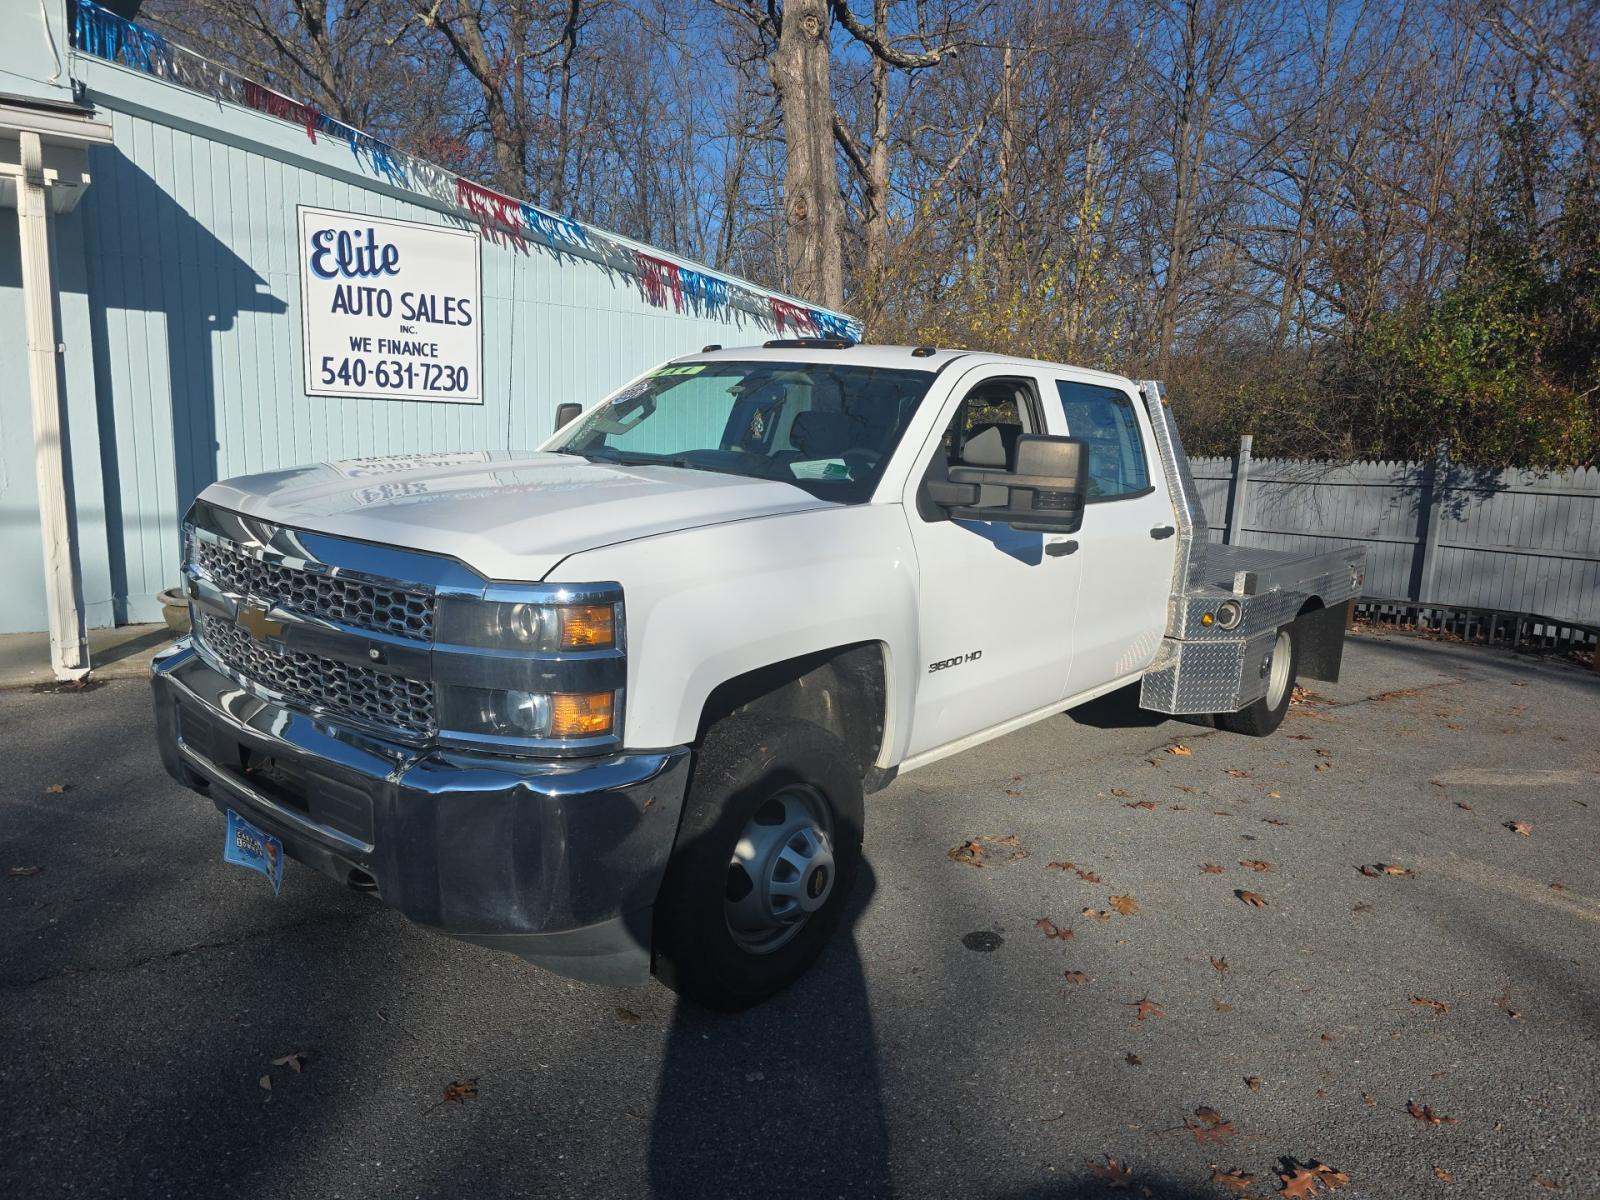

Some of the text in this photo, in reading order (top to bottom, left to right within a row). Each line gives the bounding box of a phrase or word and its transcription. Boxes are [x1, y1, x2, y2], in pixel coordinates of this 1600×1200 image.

[310, 228, 401, 280] Elite
[331, 284, 472, 327] AUTO SALES
[400, 325, 418, 334] INC.
[349, 336, 438, 358] WE FINANCE
[321, 356, 469, 392] 540-631-7230
[928, 650, 982, 673] 3500 HD
